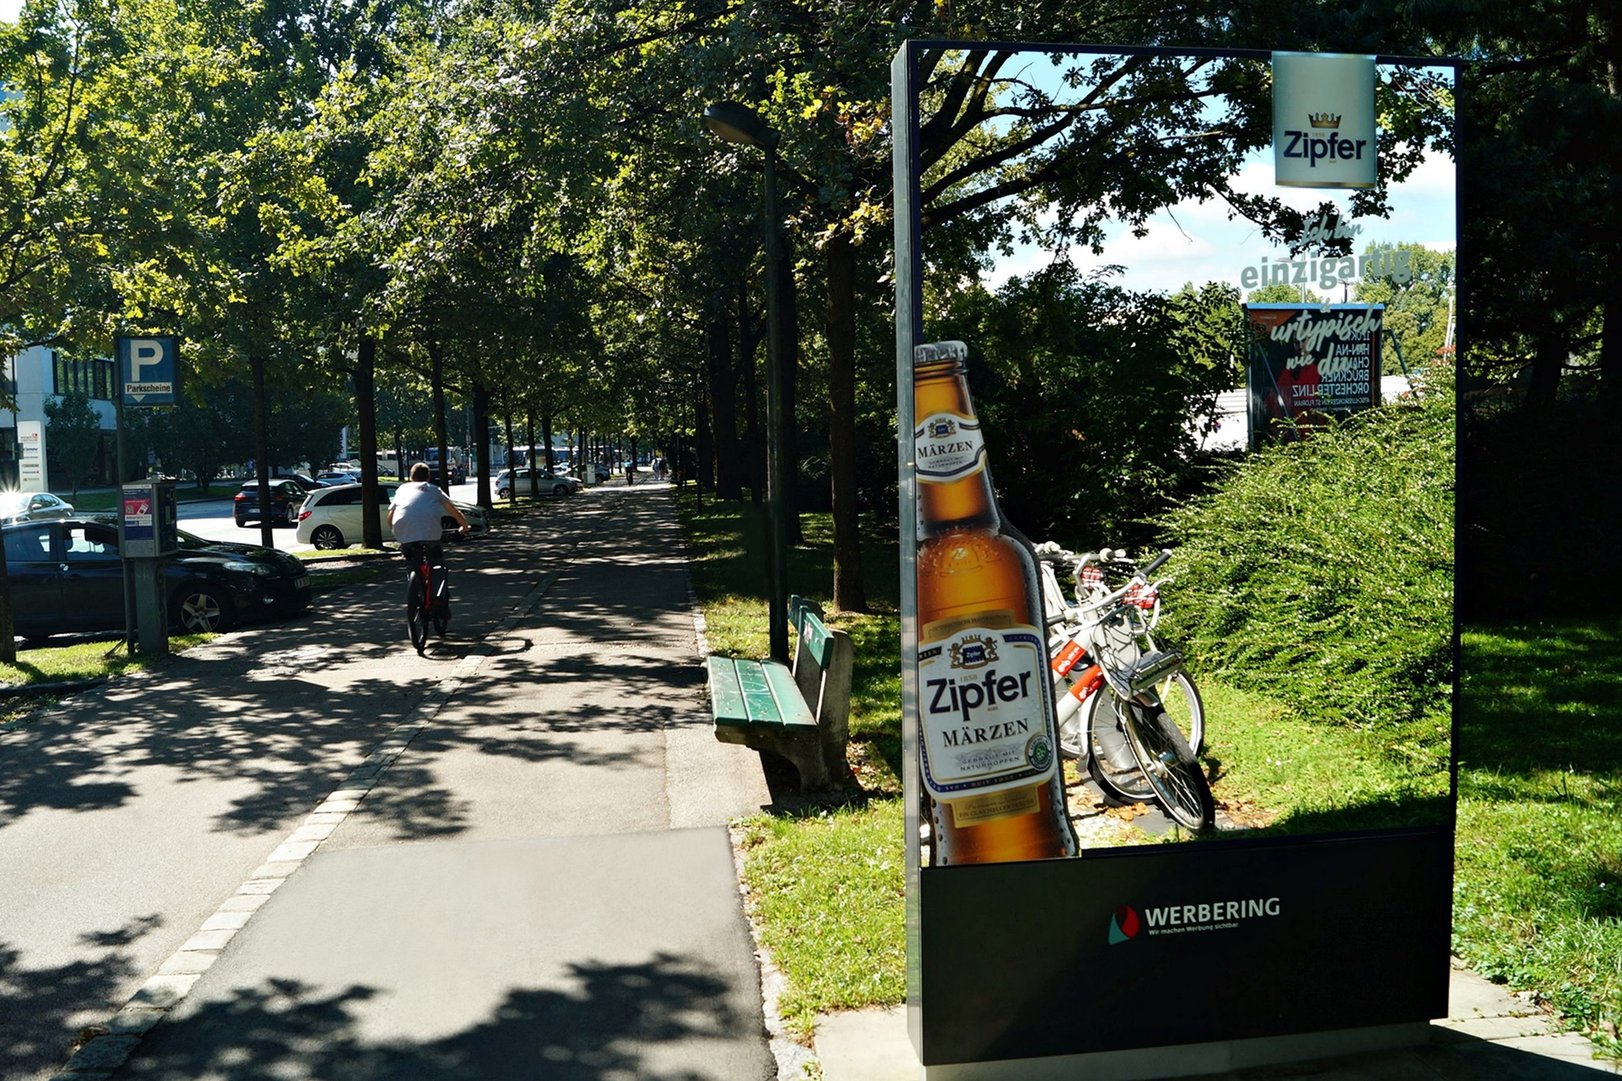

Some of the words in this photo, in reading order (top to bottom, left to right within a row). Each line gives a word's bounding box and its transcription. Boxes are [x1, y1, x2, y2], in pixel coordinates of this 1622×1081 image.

[1283, 130, 1367, 168] Zipfer
[1334, 214, 1364, 240] bin
[1240, 245, 1412, 290] einzigartig
[1270, 303, 1381, 352] urtypisch
[130, 339, 164, 382] P
[1286, 351, 1315, 370] wie
[126, 384, 171, 393] Parkscheine
[917, 440, 974, 460] MÄRZEN
[926, 669, 1031, 722] Zipfer
[942, 718, 1029, 747] MÄRZEN
[960, 756, 1020, 771] NATURHOPFEN
[1145, 897, 1280, 927] WERBERING
[1149, 928, 1160, 936] Wir
[1161, 926, 1186, 935] machen
[1186, 923, 1214, 933] Werbung
